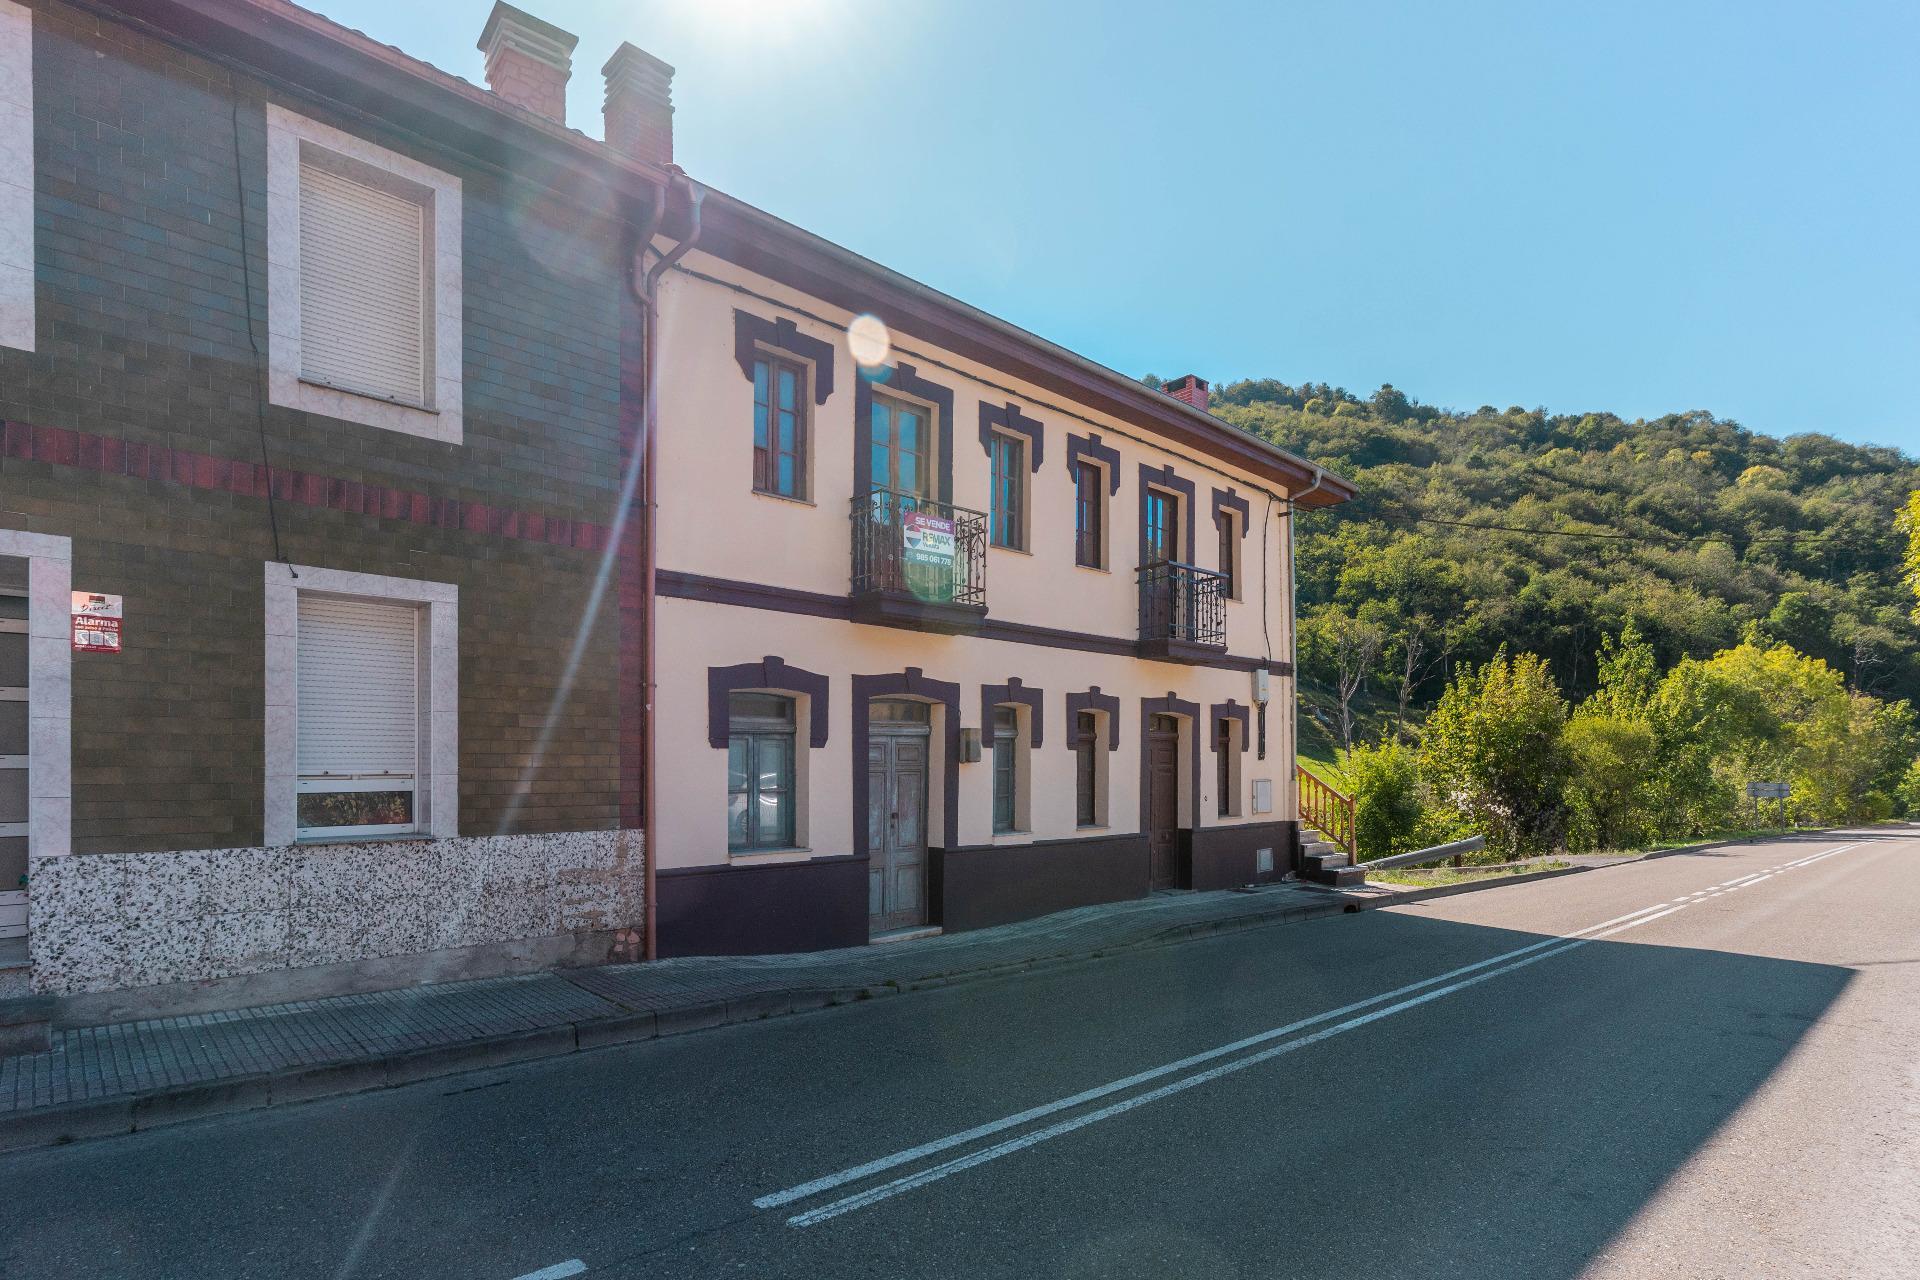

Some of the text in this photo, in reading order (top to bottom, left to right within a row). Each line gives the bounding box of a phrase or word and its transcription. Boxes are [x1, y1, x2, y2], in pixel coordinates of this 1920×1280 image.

[915, 517, 951, 531] SE VENDE
[75, 616, 119, 628] Alarma
